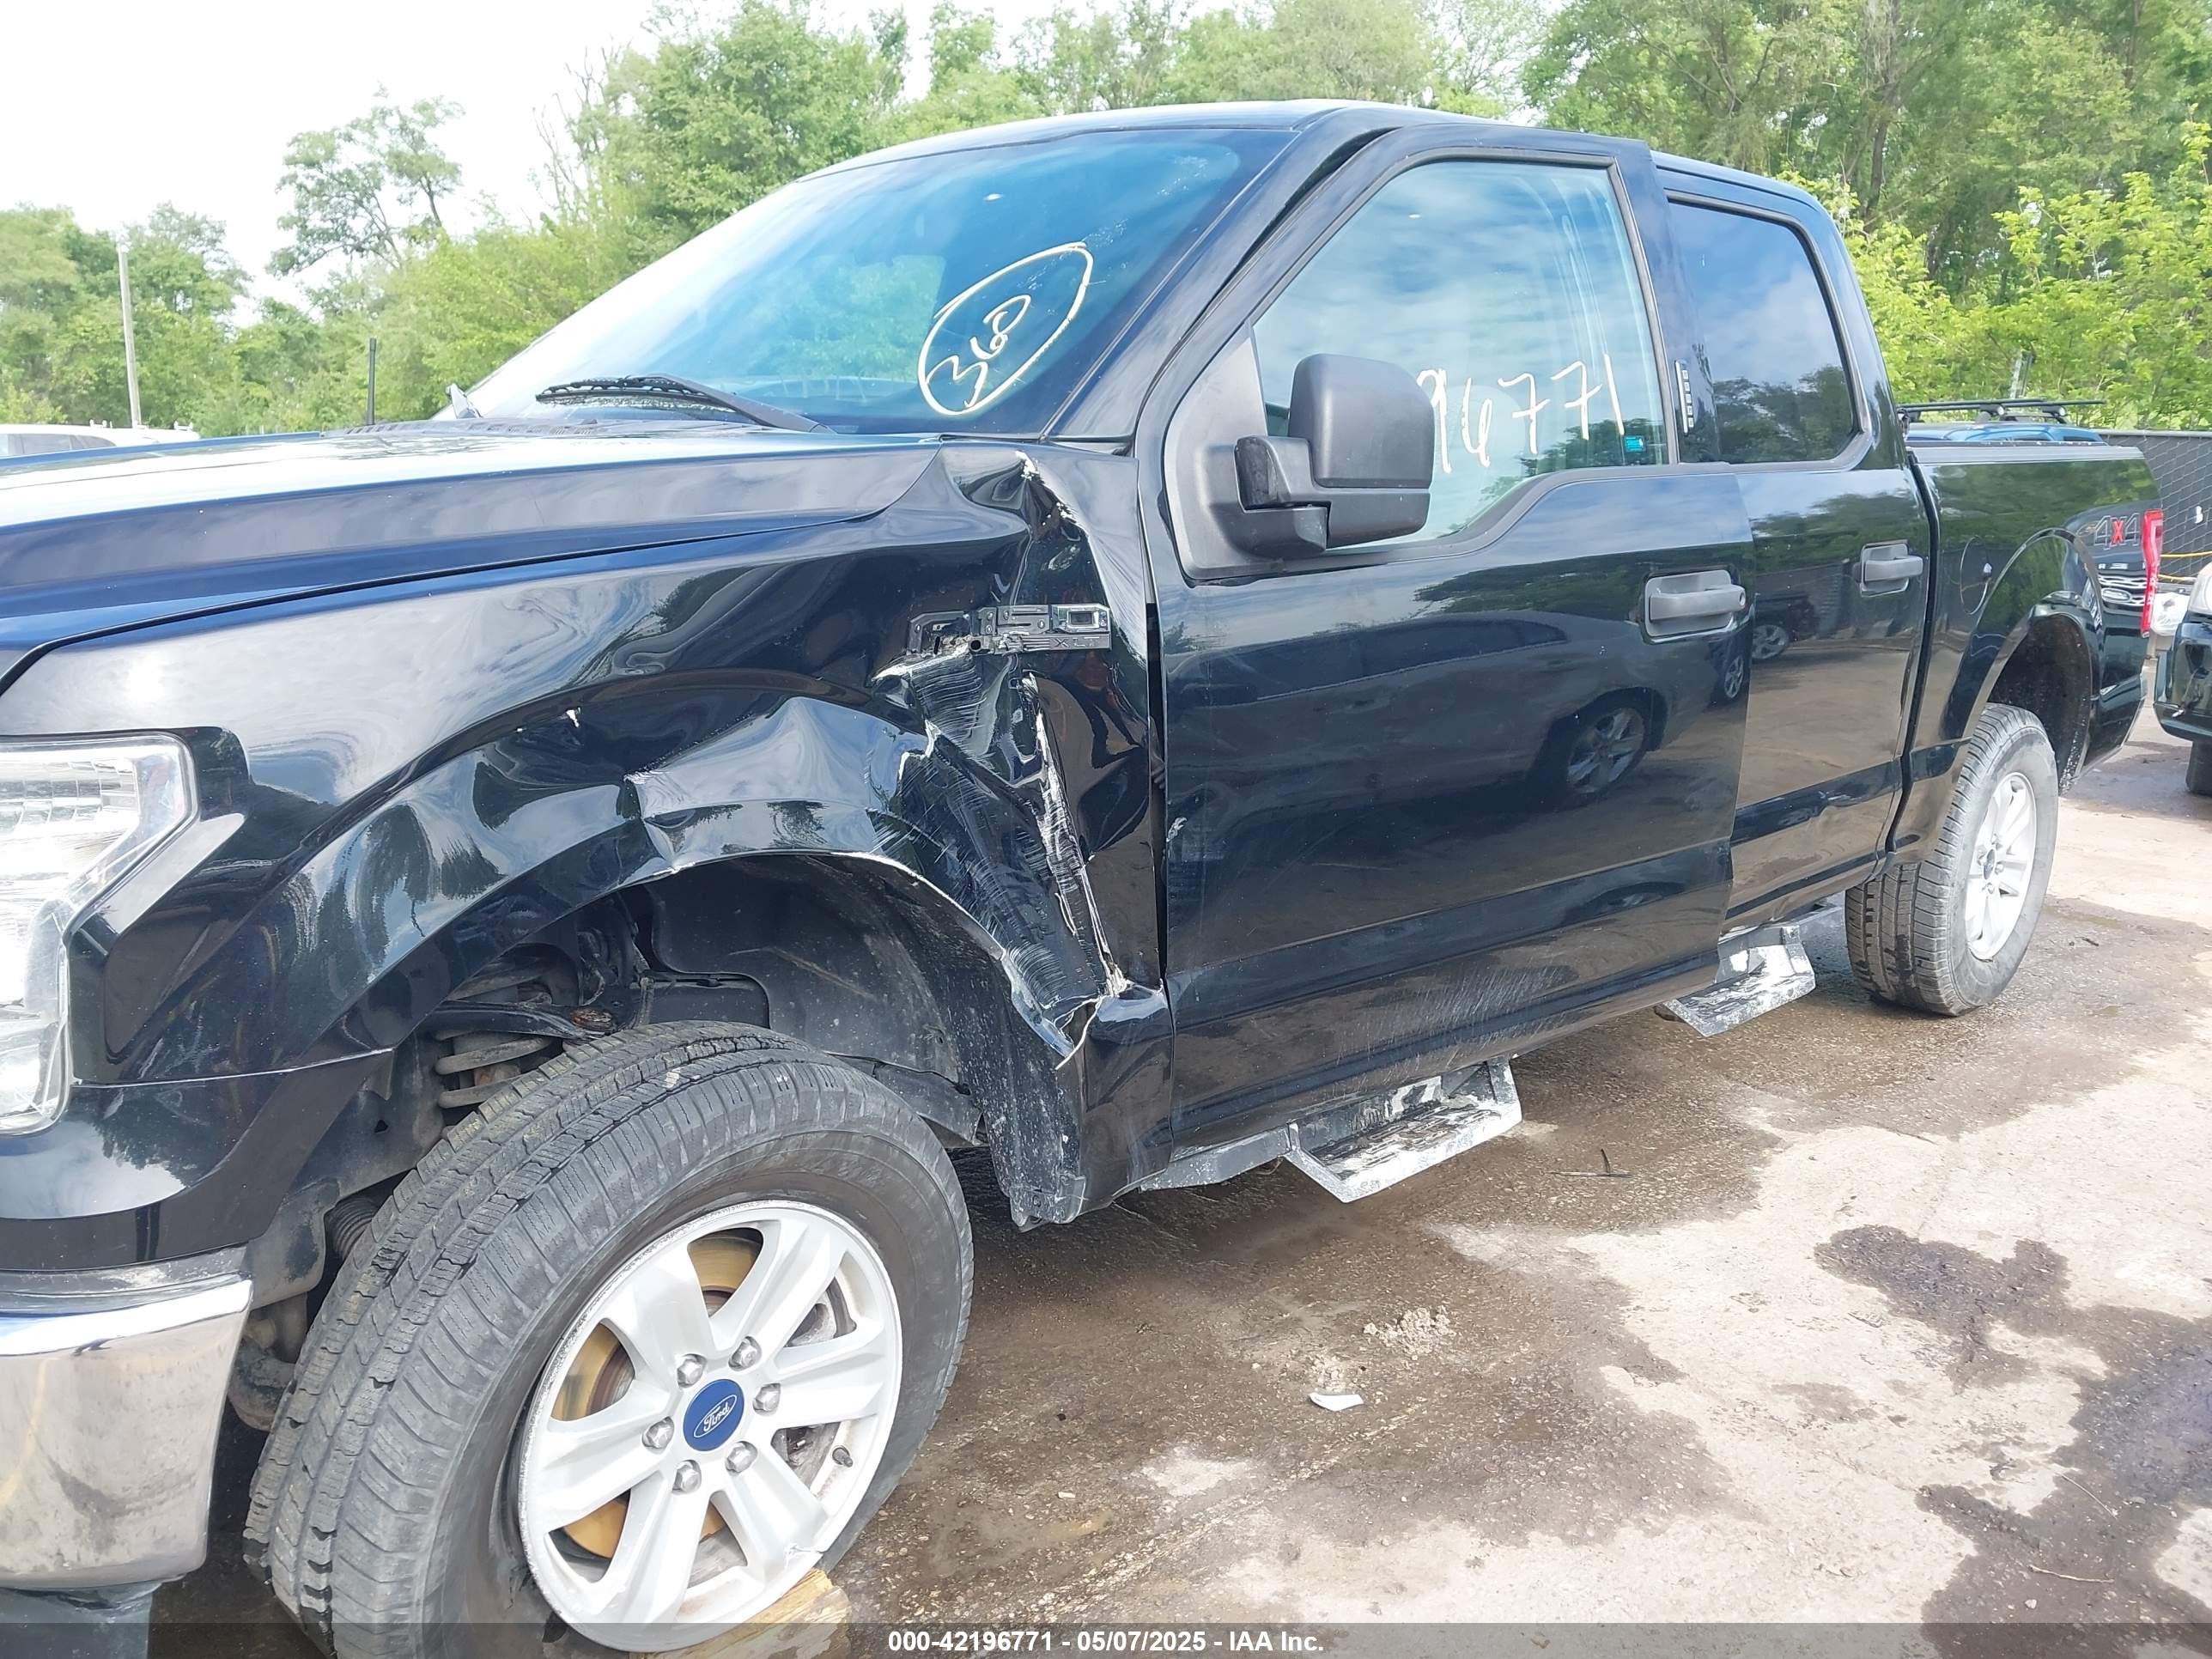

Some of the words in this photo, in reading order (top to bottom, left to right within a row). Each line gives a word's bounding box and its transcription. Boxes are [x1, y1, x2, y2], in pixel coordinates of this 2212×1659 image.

[927, 295, 1031, 408] 360
[1417, 353, 1626, 474] 96771
[703, 1401, 730, 1432] Ford
